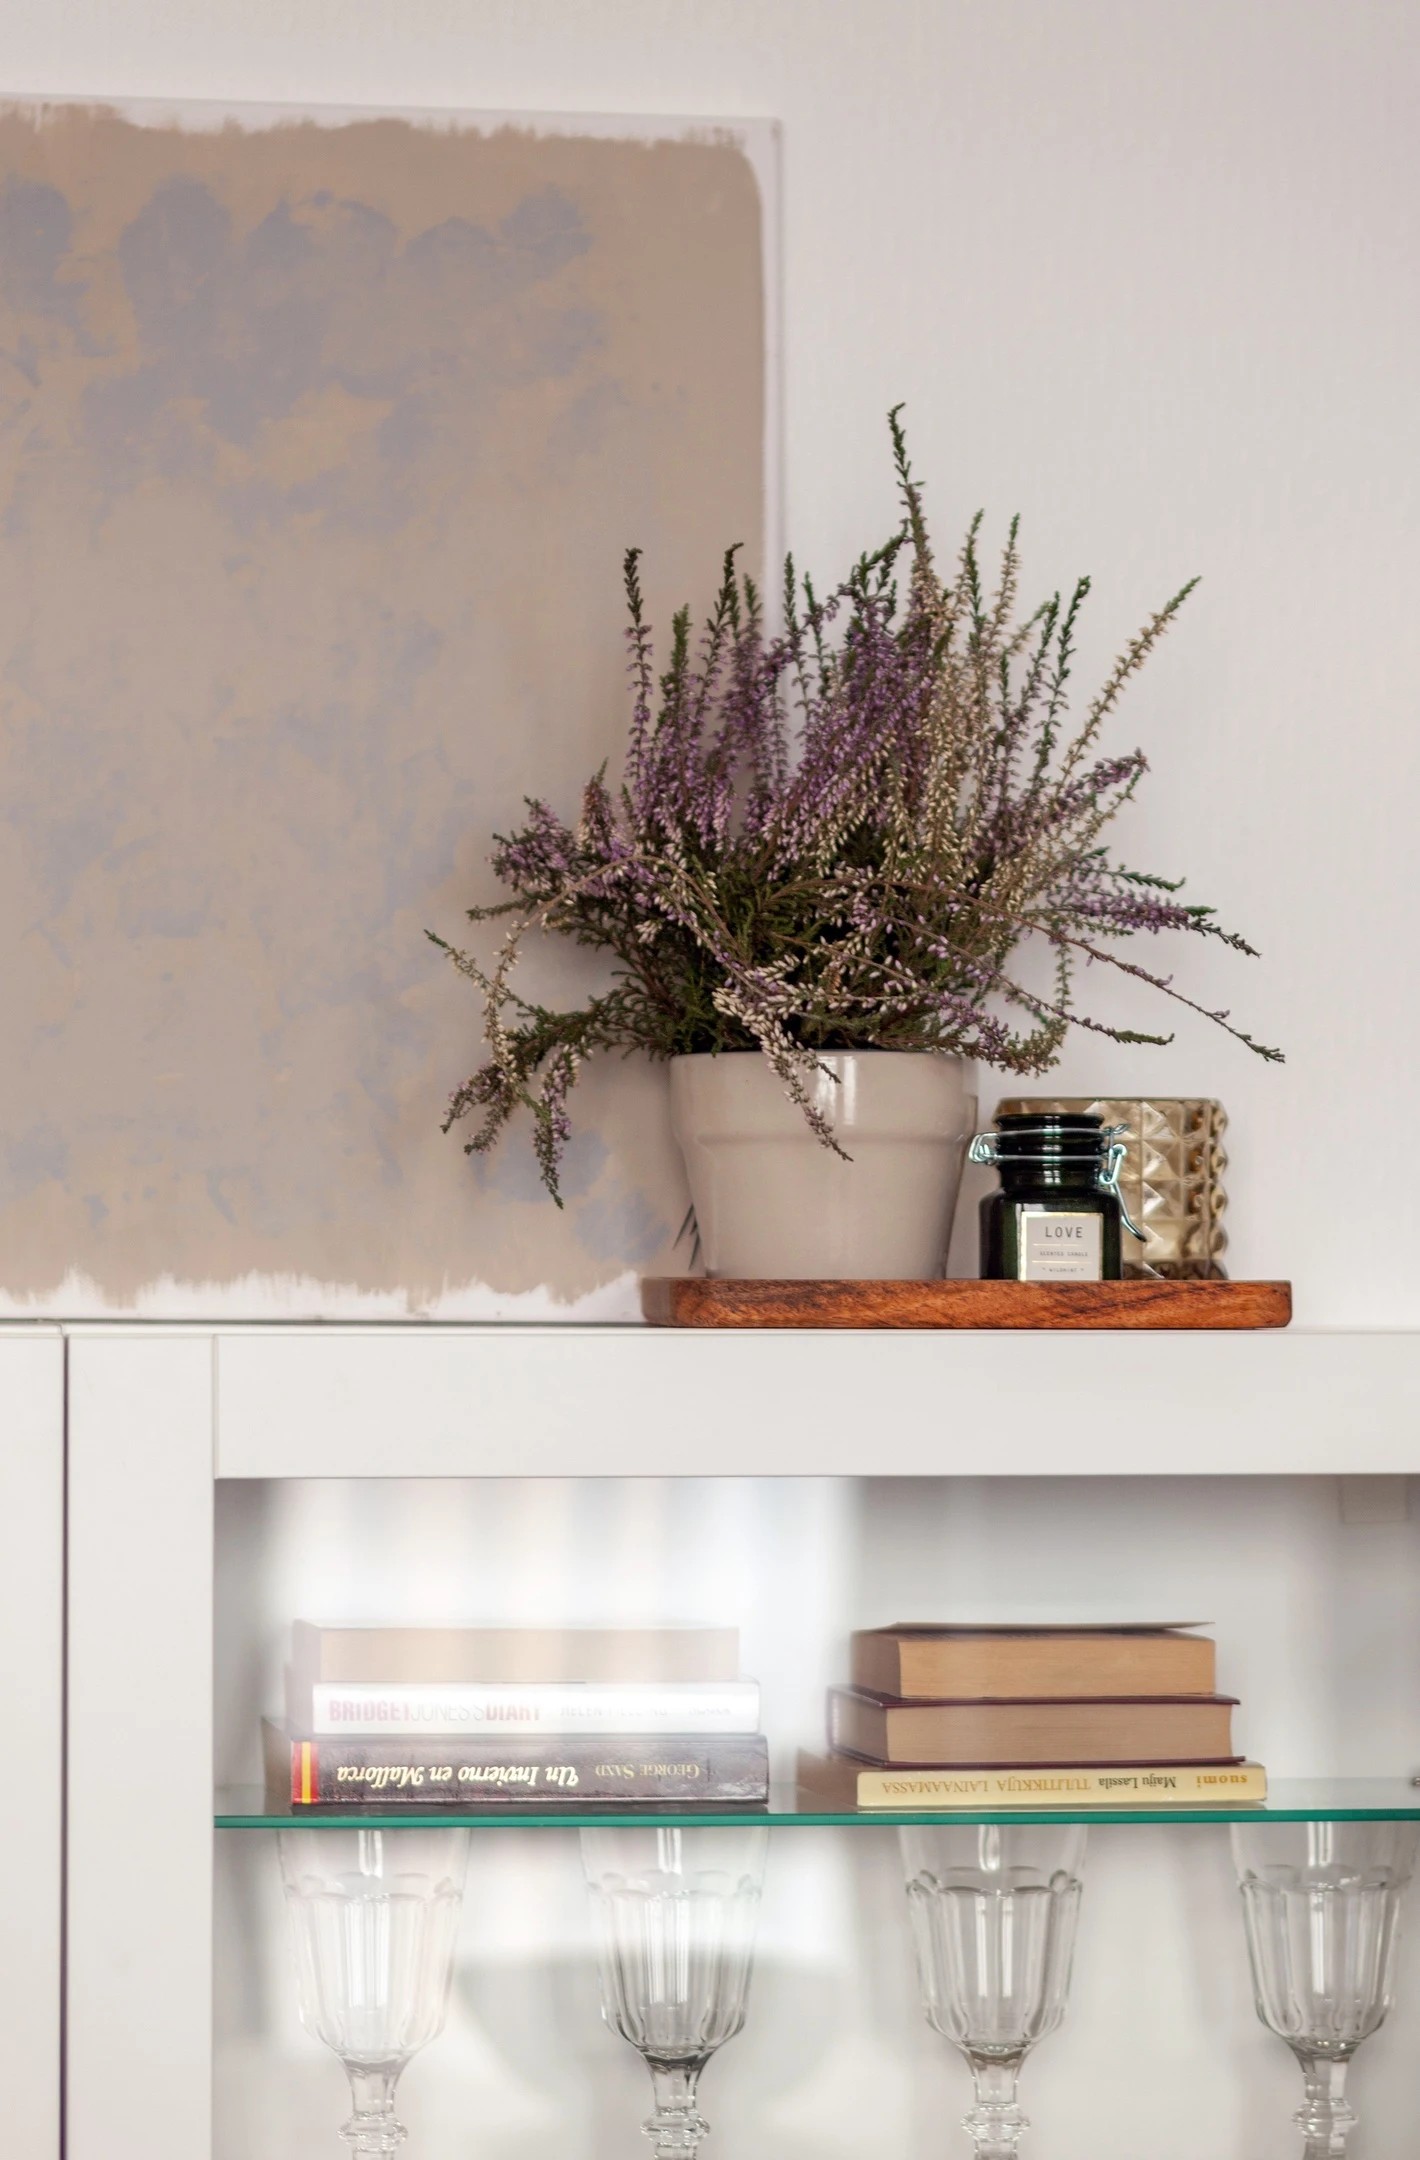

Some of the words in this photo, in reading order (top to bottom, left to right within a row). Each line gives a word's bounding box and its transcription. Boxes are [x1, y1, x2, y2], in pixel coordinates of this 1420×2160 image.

[1044, 1226, 1084, 1239] LOVE
[336, 1765, 425, 1789] Mallorca
[429, 1766, 453, 1781] en
[457, 1765, 541, 1787] Invierno
[545, 1765, 580, 1787] Un
[594, 1763, 636, 1779] SAND
[640, 1763, 701, 1779] GEORGE
[882, 1779, 989, 1794] LAINAAMASSA
[996, 1776, 1091, 1792] TULITIKKUJA
[1098, 1776, 1138, 1789] Lassila
[1142, 1773, 1177, 1789] Maiju
[1196, 1774, 1248, 1788] suomi
